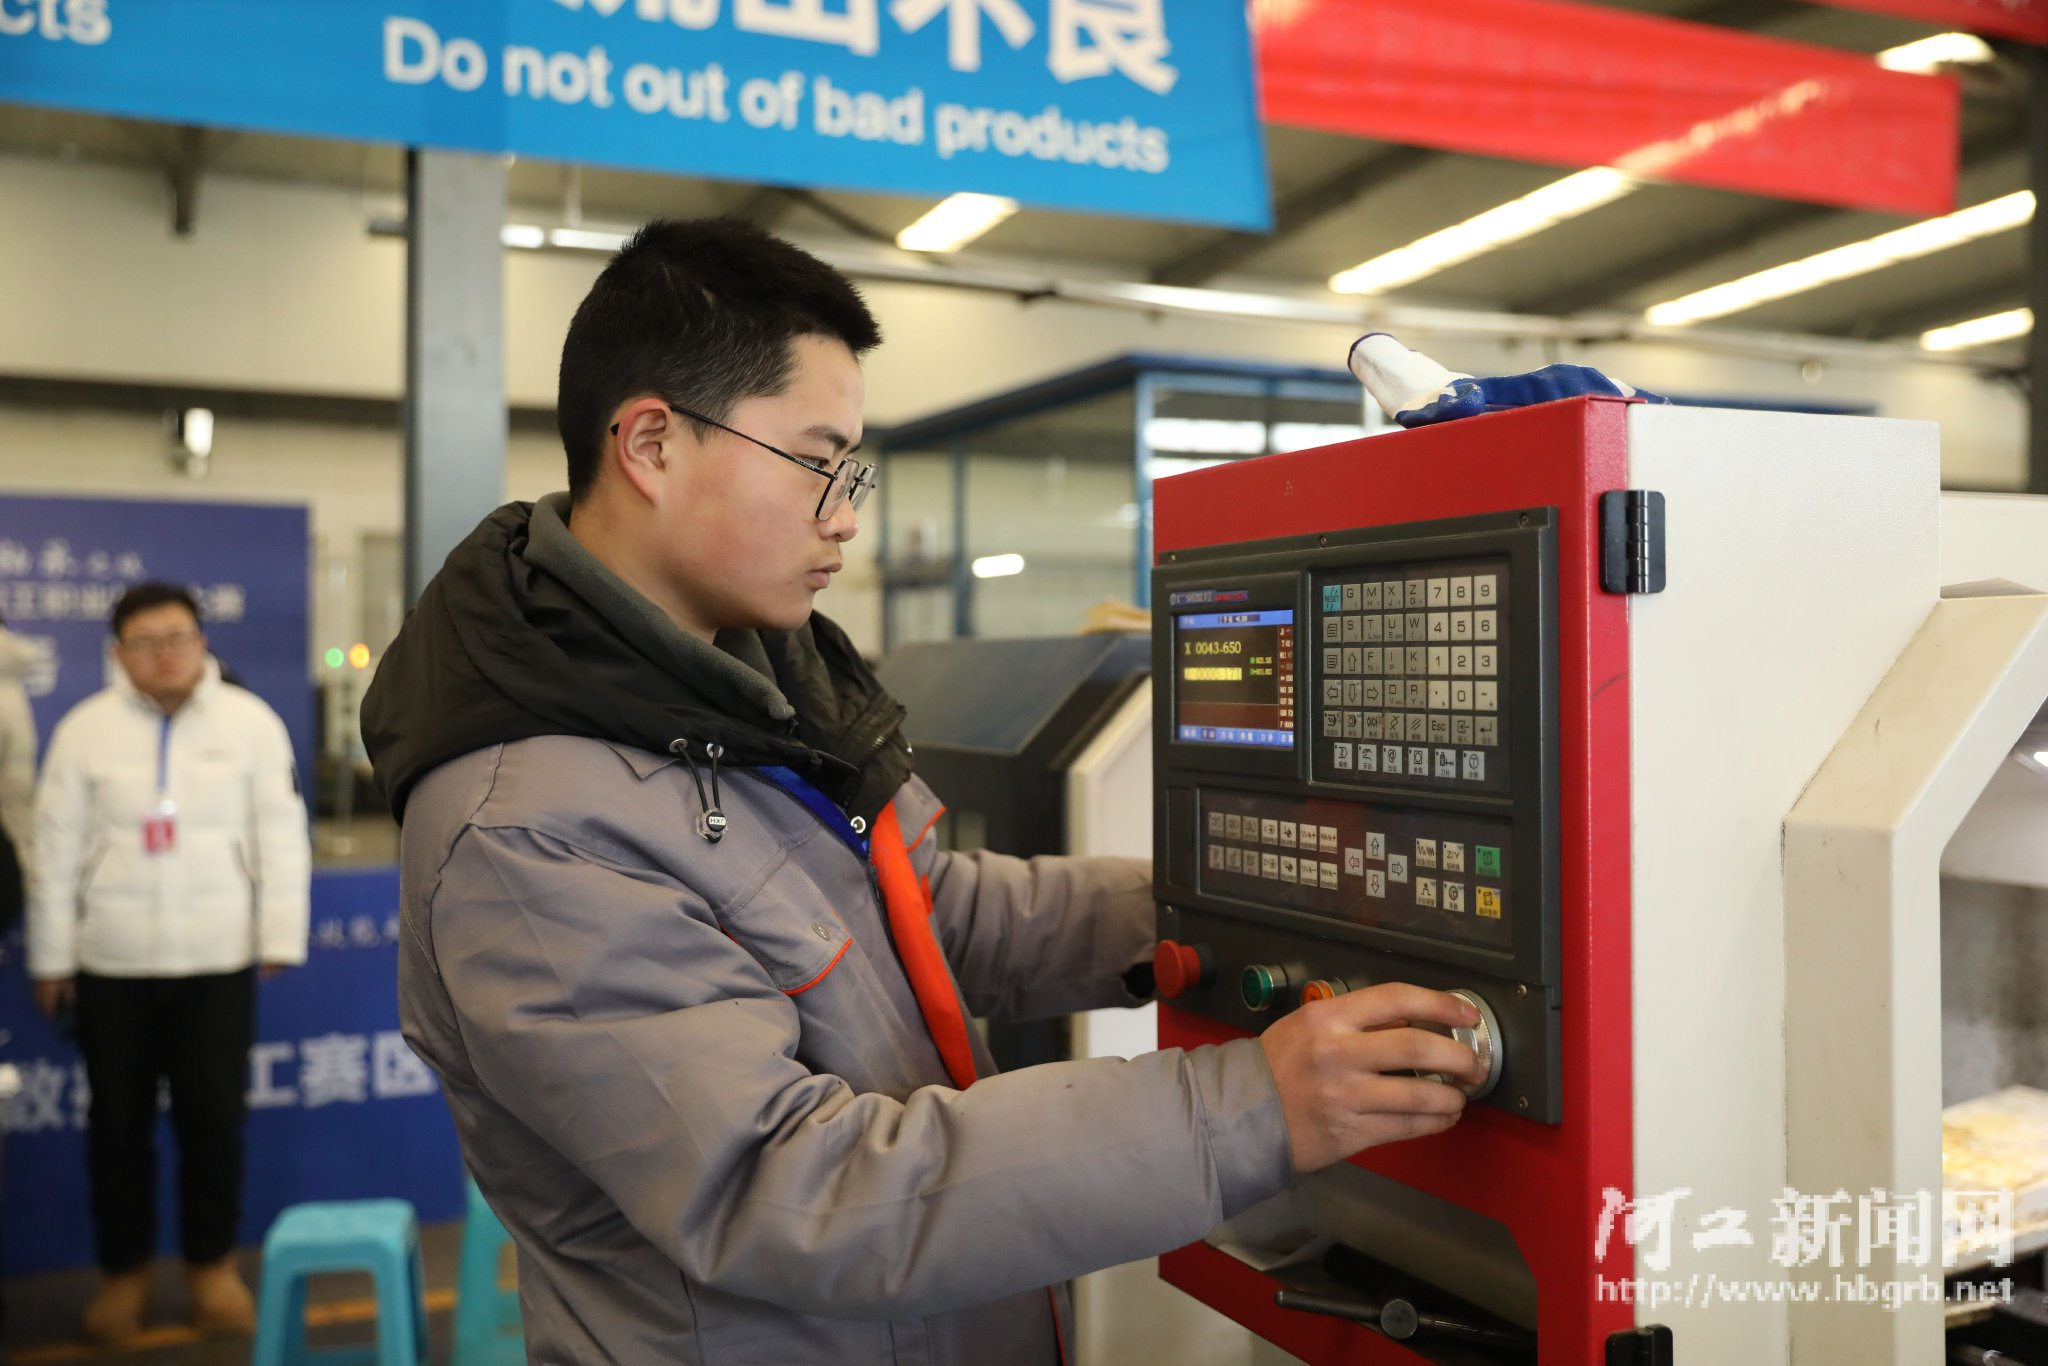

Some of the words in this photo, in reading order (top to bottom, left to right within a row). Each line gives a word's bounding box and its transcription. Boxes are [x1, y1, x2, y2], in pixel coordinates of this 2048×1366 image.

[555, 0, 1180, 96] 出不良
[383, 16, 488, 92] Do
[502, 45, 612, 108] not
[623, 62, 730, 122] out
[739, 69, 804, 130] of
[813, 76, 924, 145] bad
[934, 98, 1170, 174] products
[1347, 588, 1354, 598] G
[1367, 588, 1377, 597] M
[1388, 586, 1395, 596] X
[1410, 584, 1416, 595] Z
[1434, 587, 1442, 599] 7
[1457, 586, 1465, 598] 8
[1481, 584, 1490, 597] 9
[1325, 595, 1339, 603] RESET
[1347, 620, 1354, 630] S
[1368, 620, 1374, 629] T
[1389, 619, 1395, 628] U
[1410, 618, 1420, 628] W
[1434, 622, 1442, 632] 4
[1458, 621, 1465, 632] 5
[1481, 620, 1490, 632] 6
[1184, 642, 1191, 655] X
[1196, 641, 1242, 655] 0043.650
[1368, 652, 1374, 662] F
[1411, 652, 1417, 661] K
[1436, 656, 1440, 666] 1
[1458, 655, 1466, 667] 2
[1482, 655, 1490, 667] 3
[1457, 690, 1466, 702] 0
[1432, 720, 1446, 731] Esc
